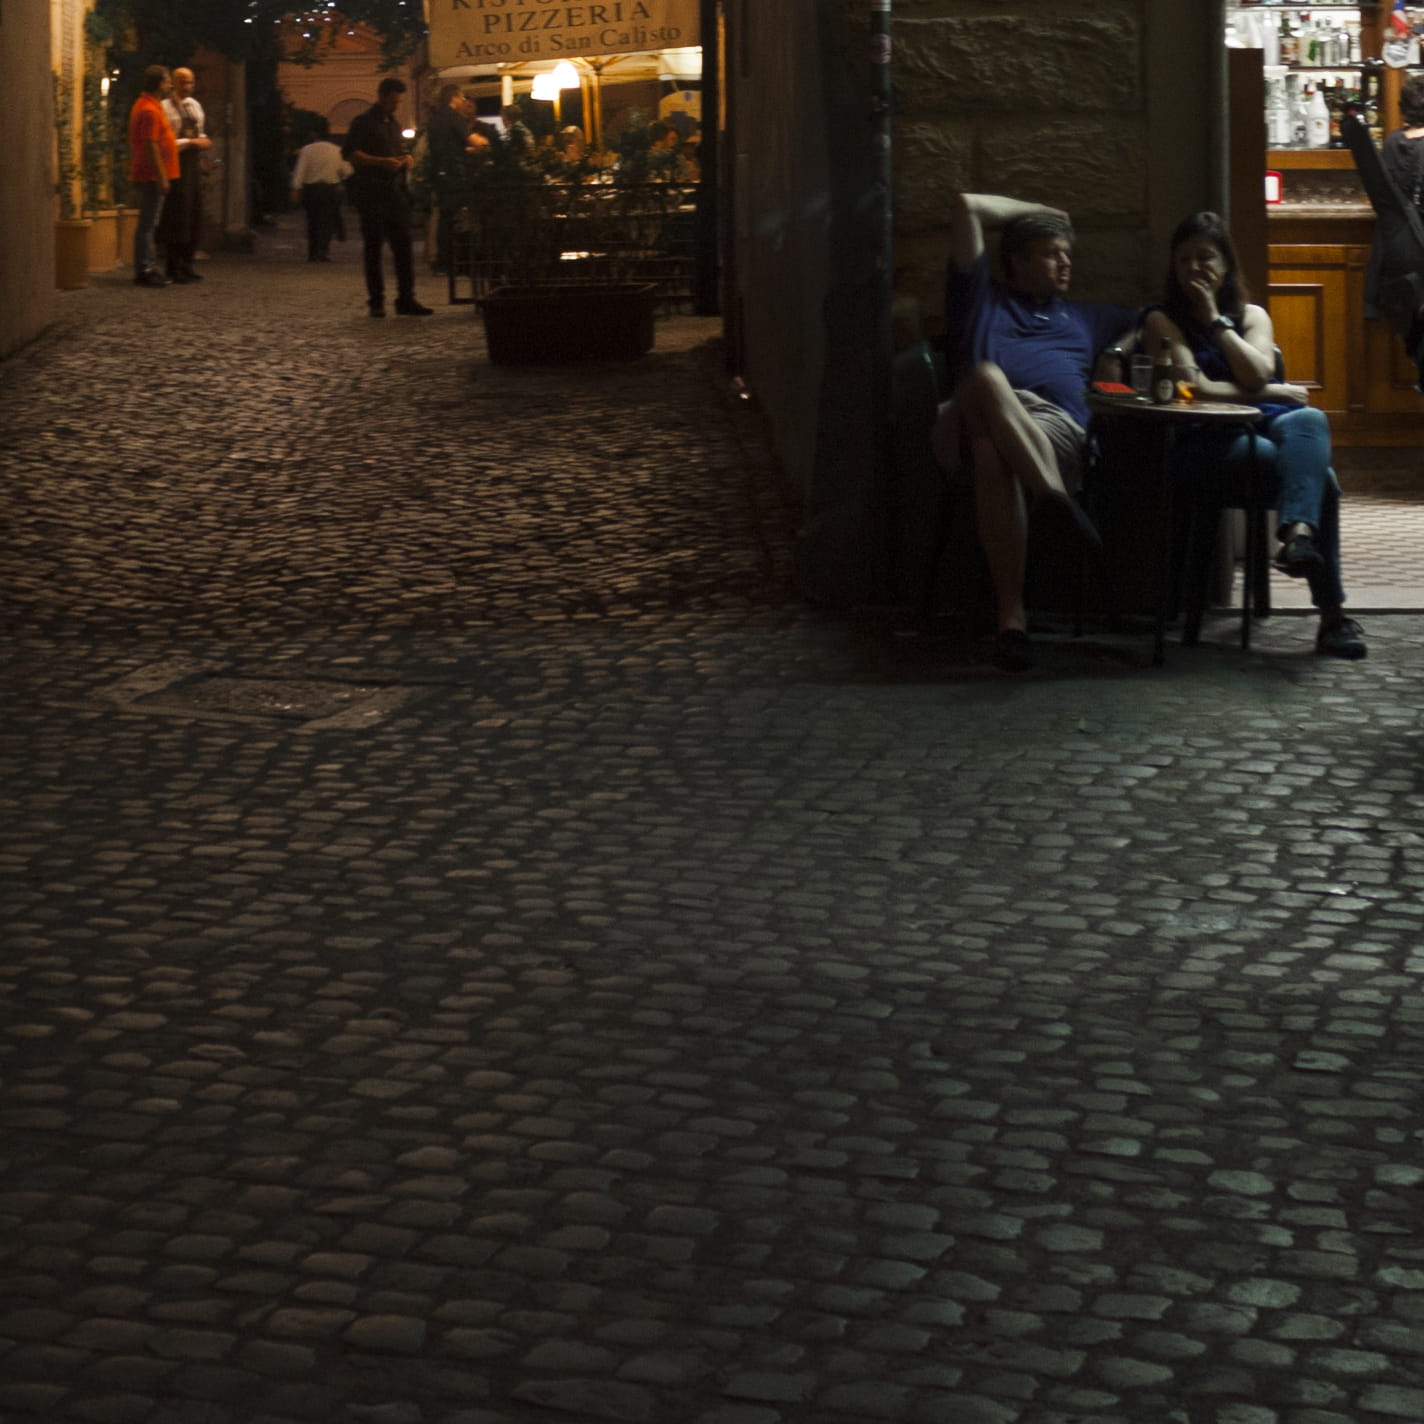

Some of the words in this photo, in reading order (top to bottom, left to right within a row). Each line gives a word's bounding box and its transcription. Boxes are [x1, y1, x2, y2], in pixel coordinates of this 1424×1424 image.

[483, 0, 651, 34] PIZZERIA
[456, 40, 510, 58] Arco
[519, 36, 541, 54] di
[550, 34, 592, 52] San
[600, 25, 682, 48] Calisto
